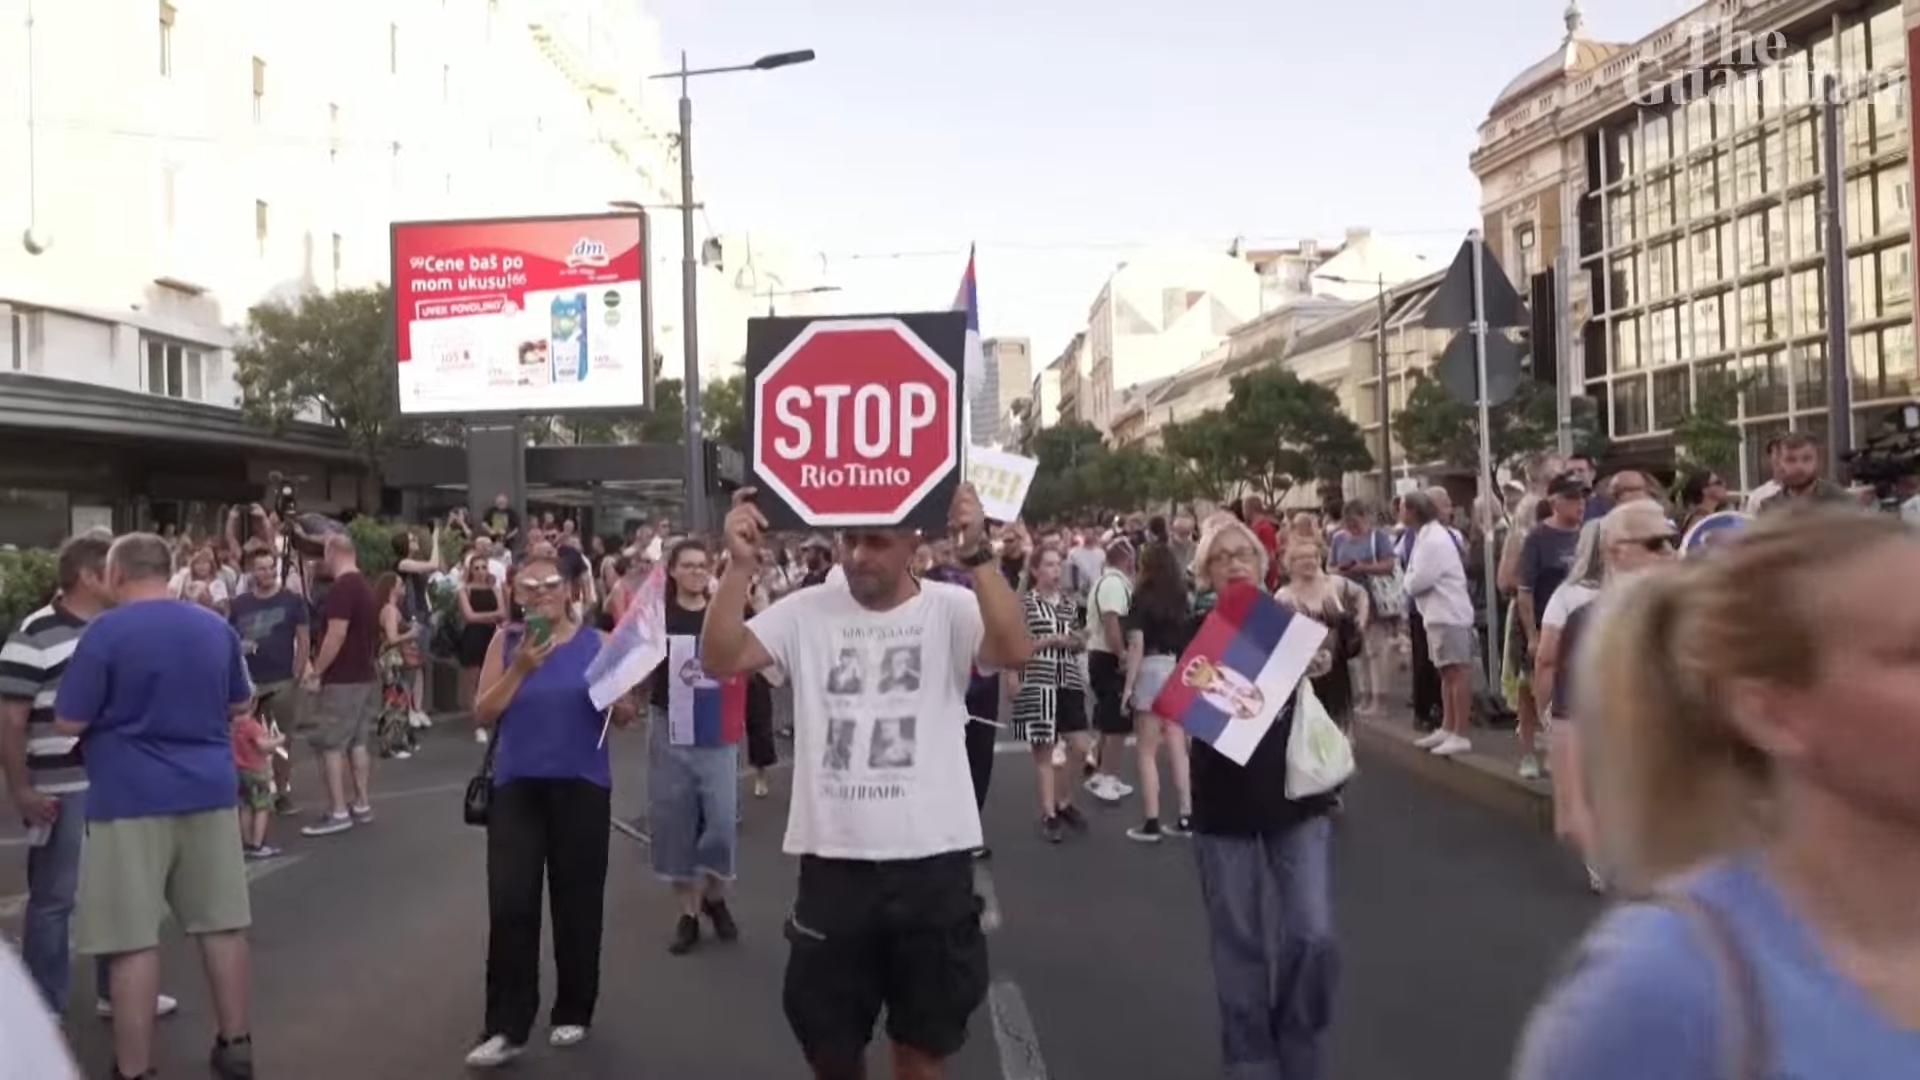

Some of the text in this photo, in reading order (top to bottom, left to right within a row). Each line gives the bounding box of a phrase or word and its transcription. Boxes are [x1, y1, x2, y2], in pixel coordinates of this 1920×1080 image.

[574, 239, 602, 255] dm
[469, 253, 498, 270] baš
[503, 256, 524, 273] po
[412, 278, 453, 292] mom
[774, 382, 936, 459] STOP
